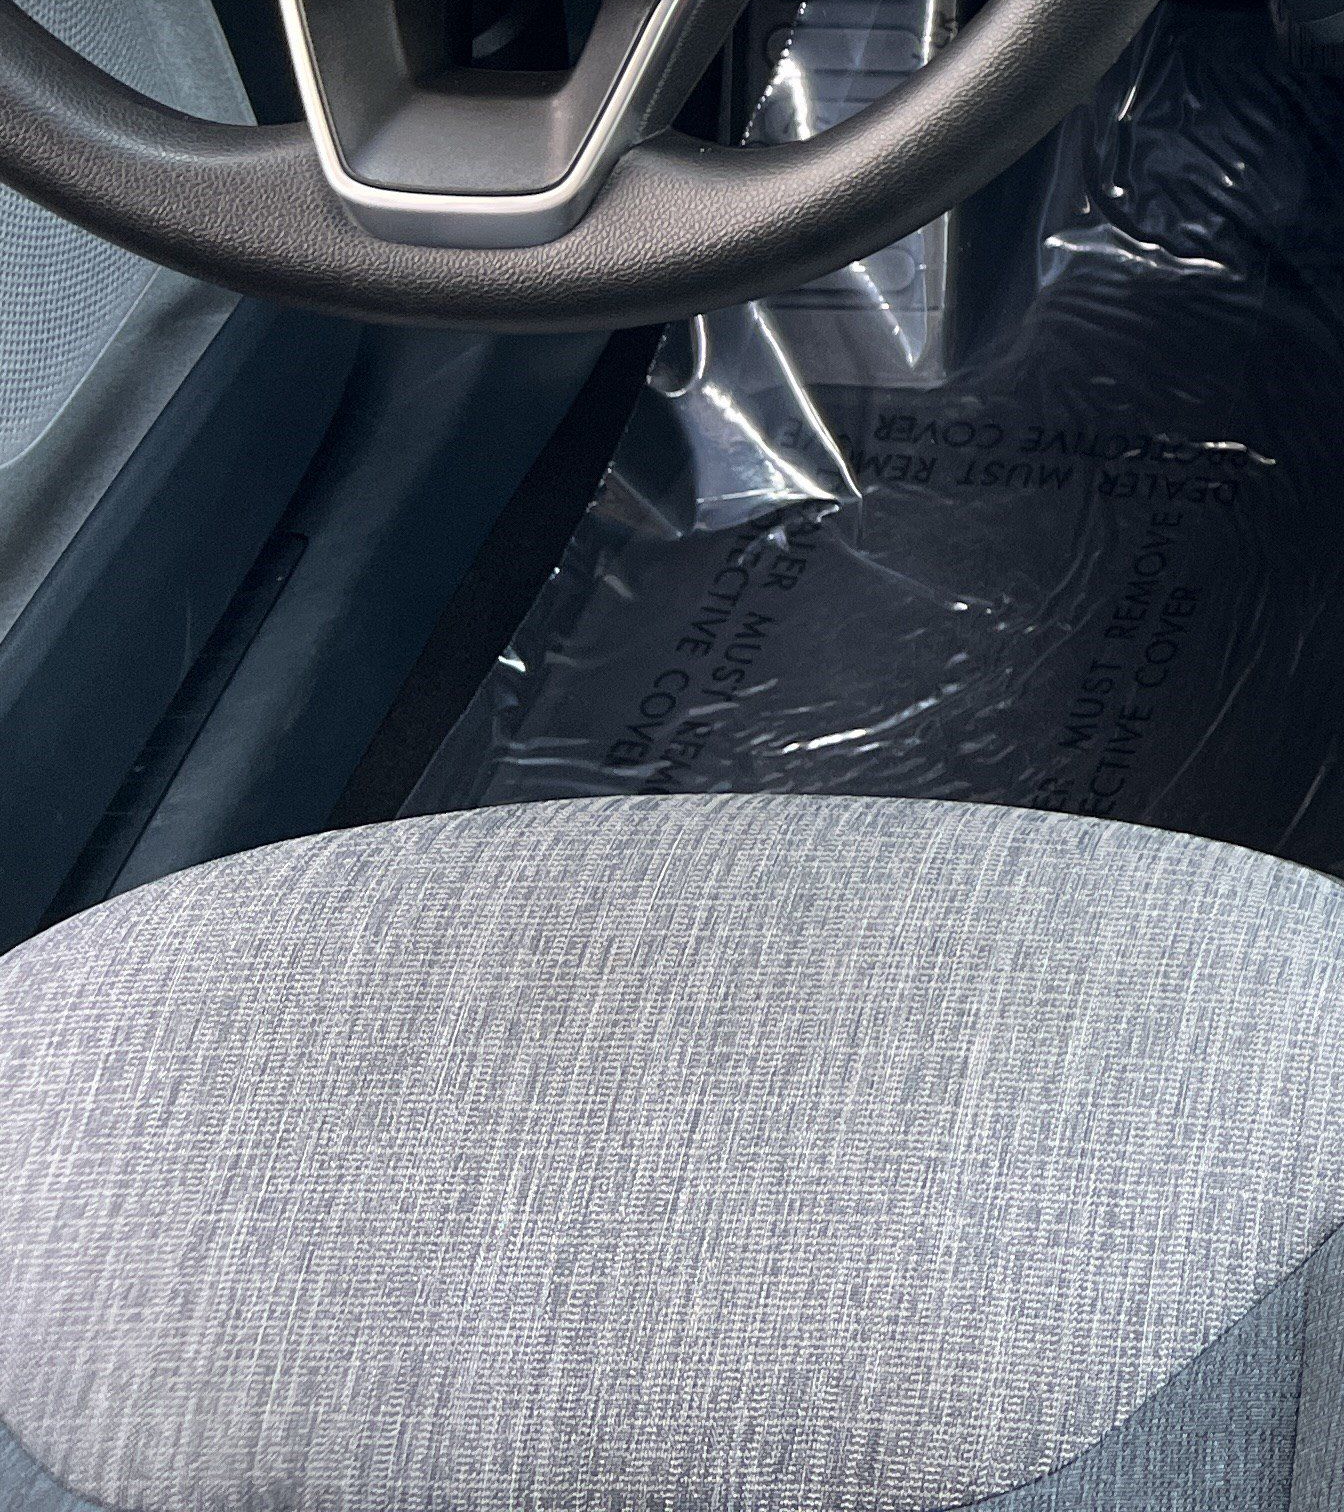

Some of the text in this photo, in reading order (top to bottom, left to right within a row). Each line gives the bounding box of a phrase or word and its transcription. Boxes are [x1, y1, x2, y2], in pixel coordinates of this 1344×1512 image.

[875, 412, 1005, 450] COVER
[1104, 510, 1184, 639] REMOVE
[1133, 585, 1201, 689] COVER
